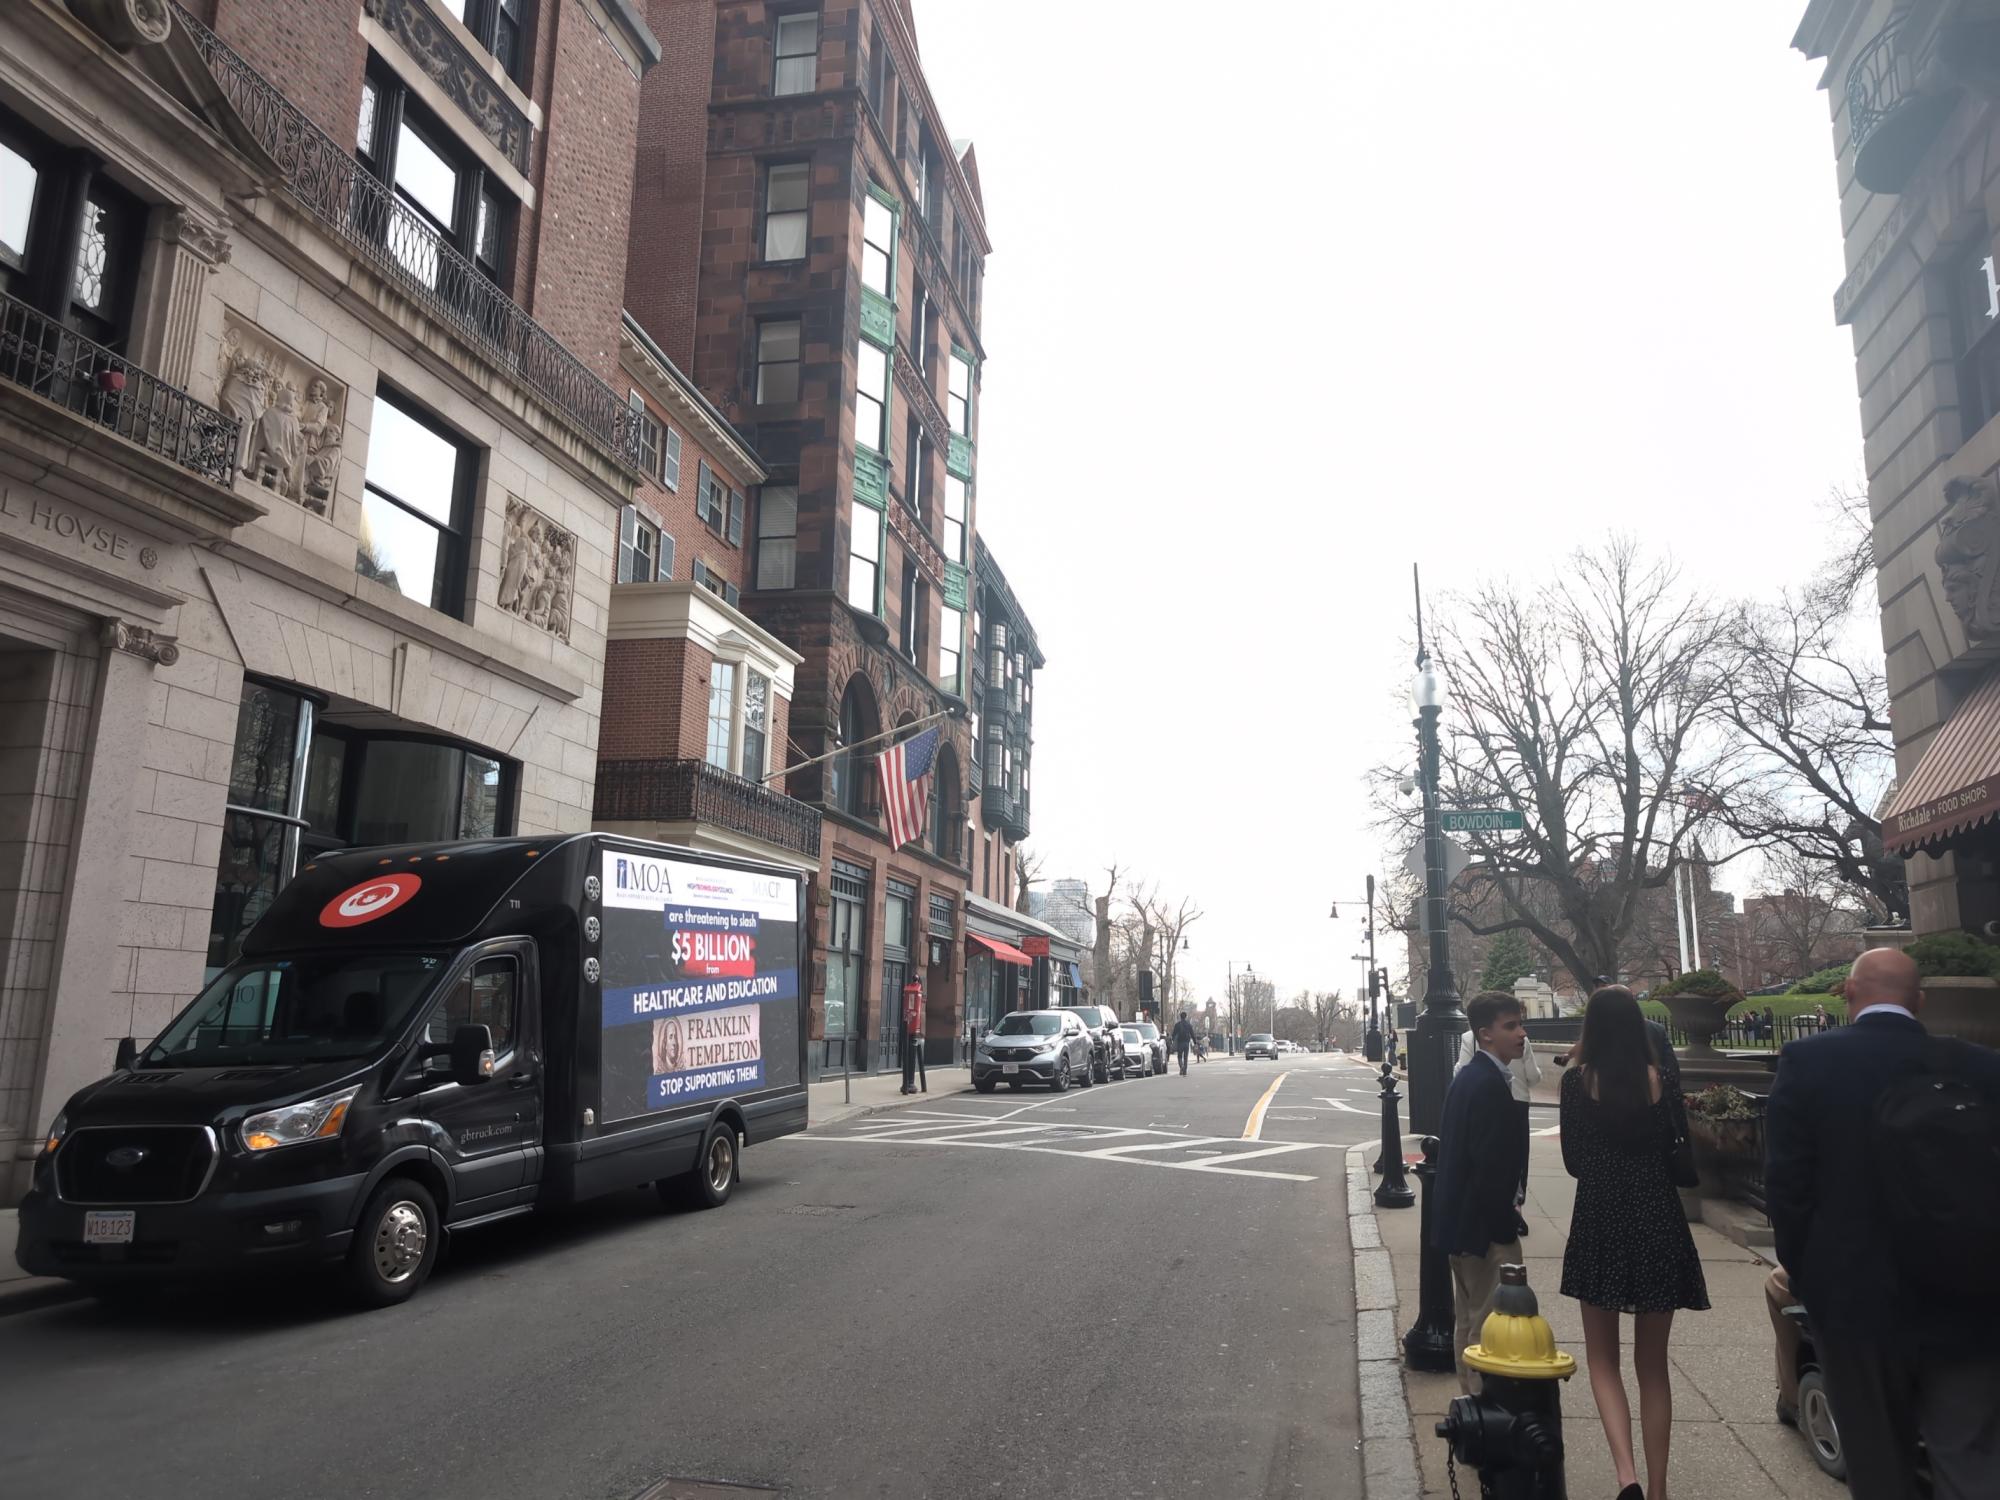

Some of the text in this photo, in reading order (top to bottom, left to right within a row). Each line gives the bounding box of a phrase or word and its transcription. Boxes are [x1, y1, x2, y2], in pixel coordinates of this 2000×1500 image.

[30, 499, 130, 562] HOVSE
[1449, 815, 1512, 830] BOWDOIN ST
[1898, 785, 1988, 833] Richdale FOOD SHOPS
[630, 861, 672, 894] MOA
[668, 908, 757, 930] are threatening to slash
[671, 929, 751, 965] $5 BILLION
[706, 963, 720, 974] from
[633, 976, 778, 1014] HEALTHCARE AND EDUCATION
[687, 1014, 752, 1041] FRANKLIN
[687, 1039, 759, 1068] TEMPLETON
[660, 1065, 758, 1097] STOP SUPPORTING THEM!
[460, 1123, 513, 1145] gbtruck.com
